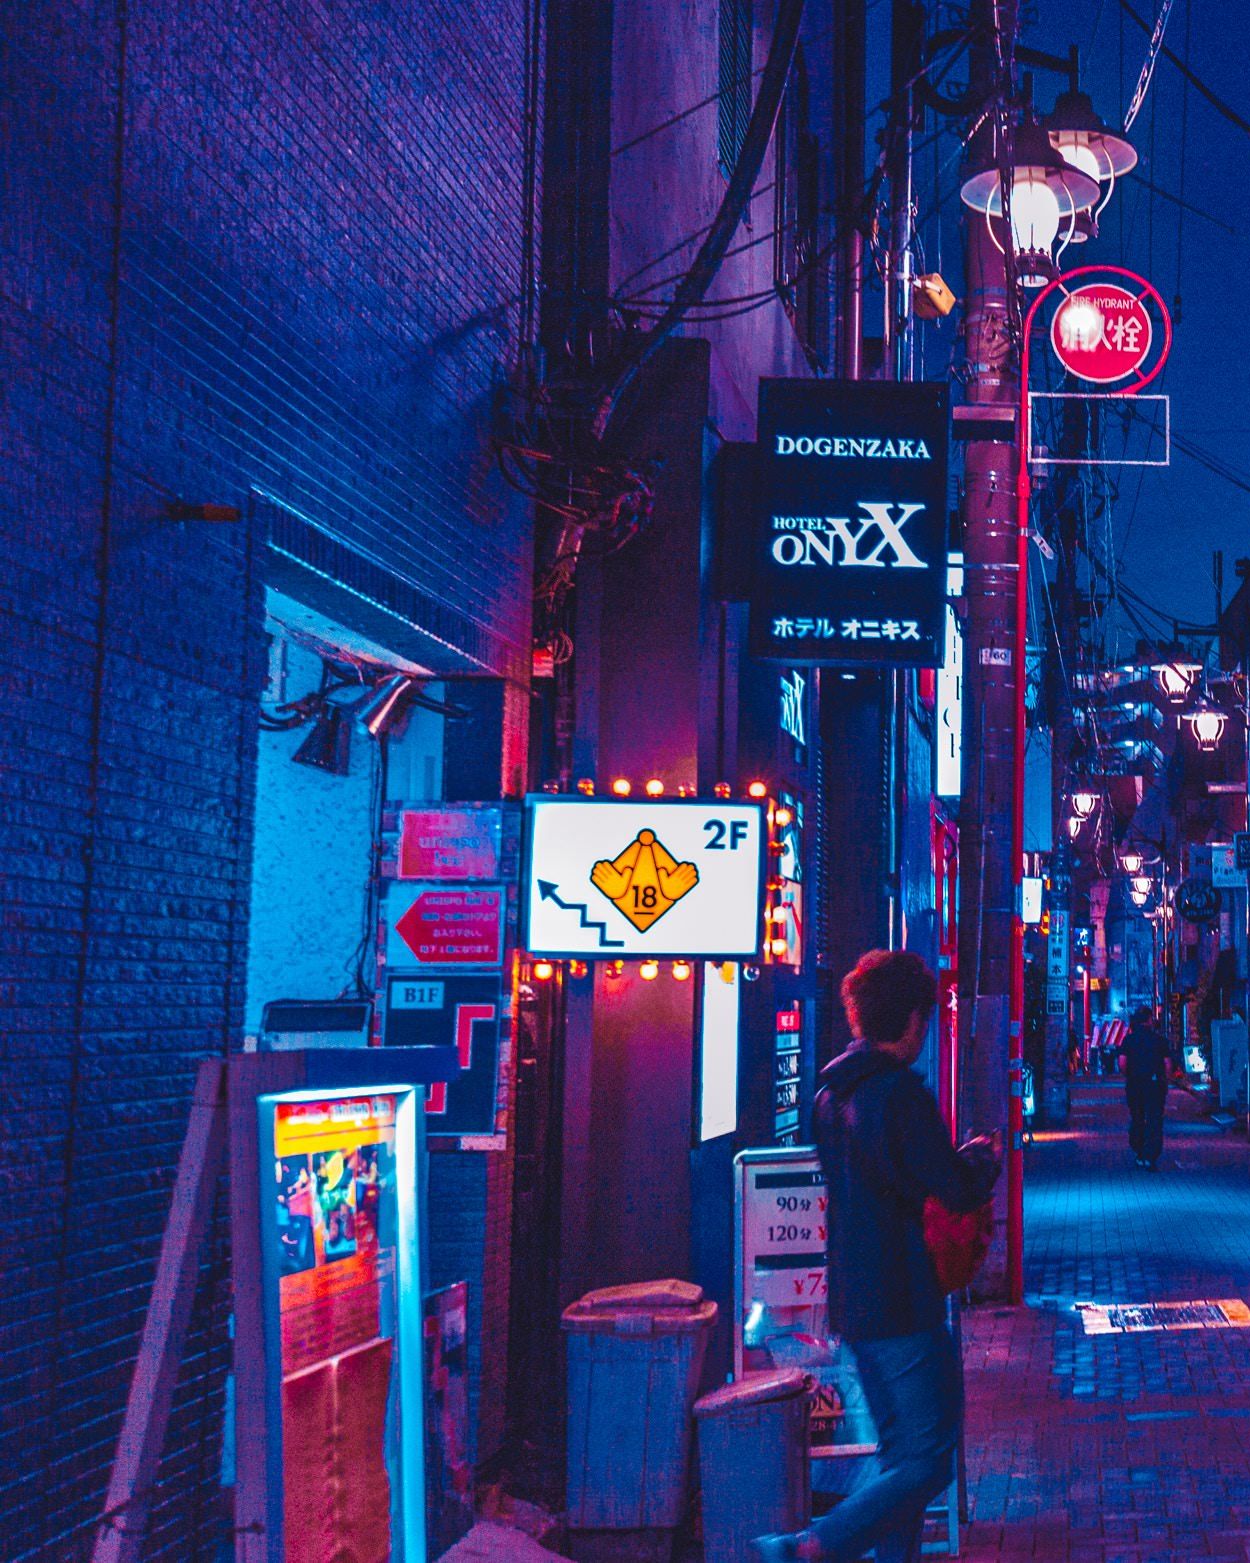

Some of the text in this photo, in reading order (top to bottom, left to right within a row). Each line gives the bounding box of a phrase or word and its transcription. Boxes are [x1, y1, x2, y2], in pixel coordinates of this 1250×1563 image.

[1093, 297, 1135, 310] HYDRANT
[775, 435, 932, 460] DOGENZAKA
[771, 501, 929, 569] ONYX
[774, 516, 827, 532] HOTEL
[773, 617, 921, 641] ホテル オニキス
[703, 819, 749, 851] 2F
[632, 885, 657, 909] 18
[404, 987, 440, 1004] B1F
